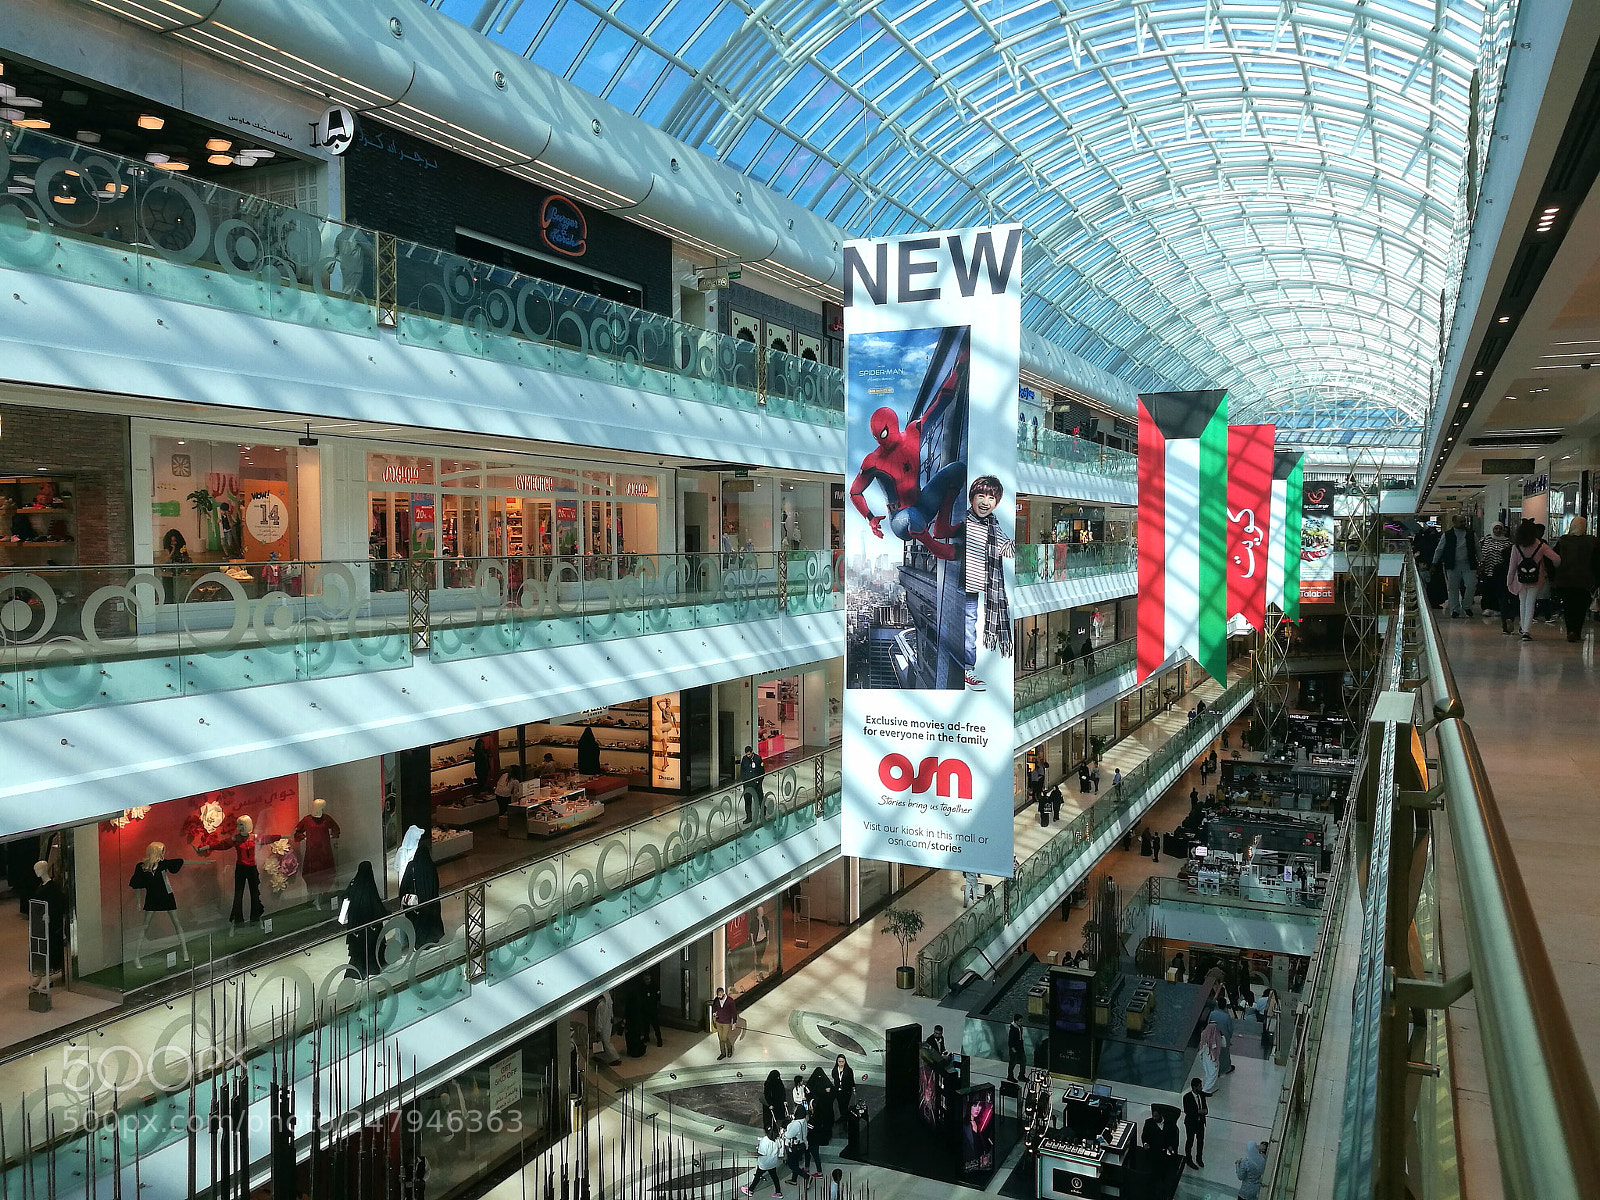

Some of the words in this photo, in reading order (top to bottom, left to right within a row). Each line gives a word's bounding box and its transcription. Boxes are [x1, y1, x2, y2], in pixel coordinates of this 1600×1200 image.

[276, 130, 293, 142] باشا
[843, 229, 1022, 307] NEW
[260, 504, 280, 526] 14
[866, 715, 908, 726] Exclusive
[910, 719, 945, 730] movies
[947, 721, 987, 733] ad-free
[862, 725, 878, 736] for
[879, 728, 924, 741] everyone
[926, 731, 936, 741] in
[937, 732, 955, 743] the
[957, 734, 989, 747] family
[878, 752, 972, 800] osn
[877, 794, 907, 807] Stories
[907, 798, 929, 814] bring
[940, 802, 973, 816] together
[863, 820, 882, 832] Visit
[883, 824, 900, 834] our
[901, 824, 925, 837] kiosk
[926, 828, 936, 839] in
[936, 829, 953, 841] this
[955, 833, 976, 844] mall
[977, 836, 990, 845] or
[887, 836, 963, 854] osn.com/stories
[500, 1062, 511, 1074] GET
